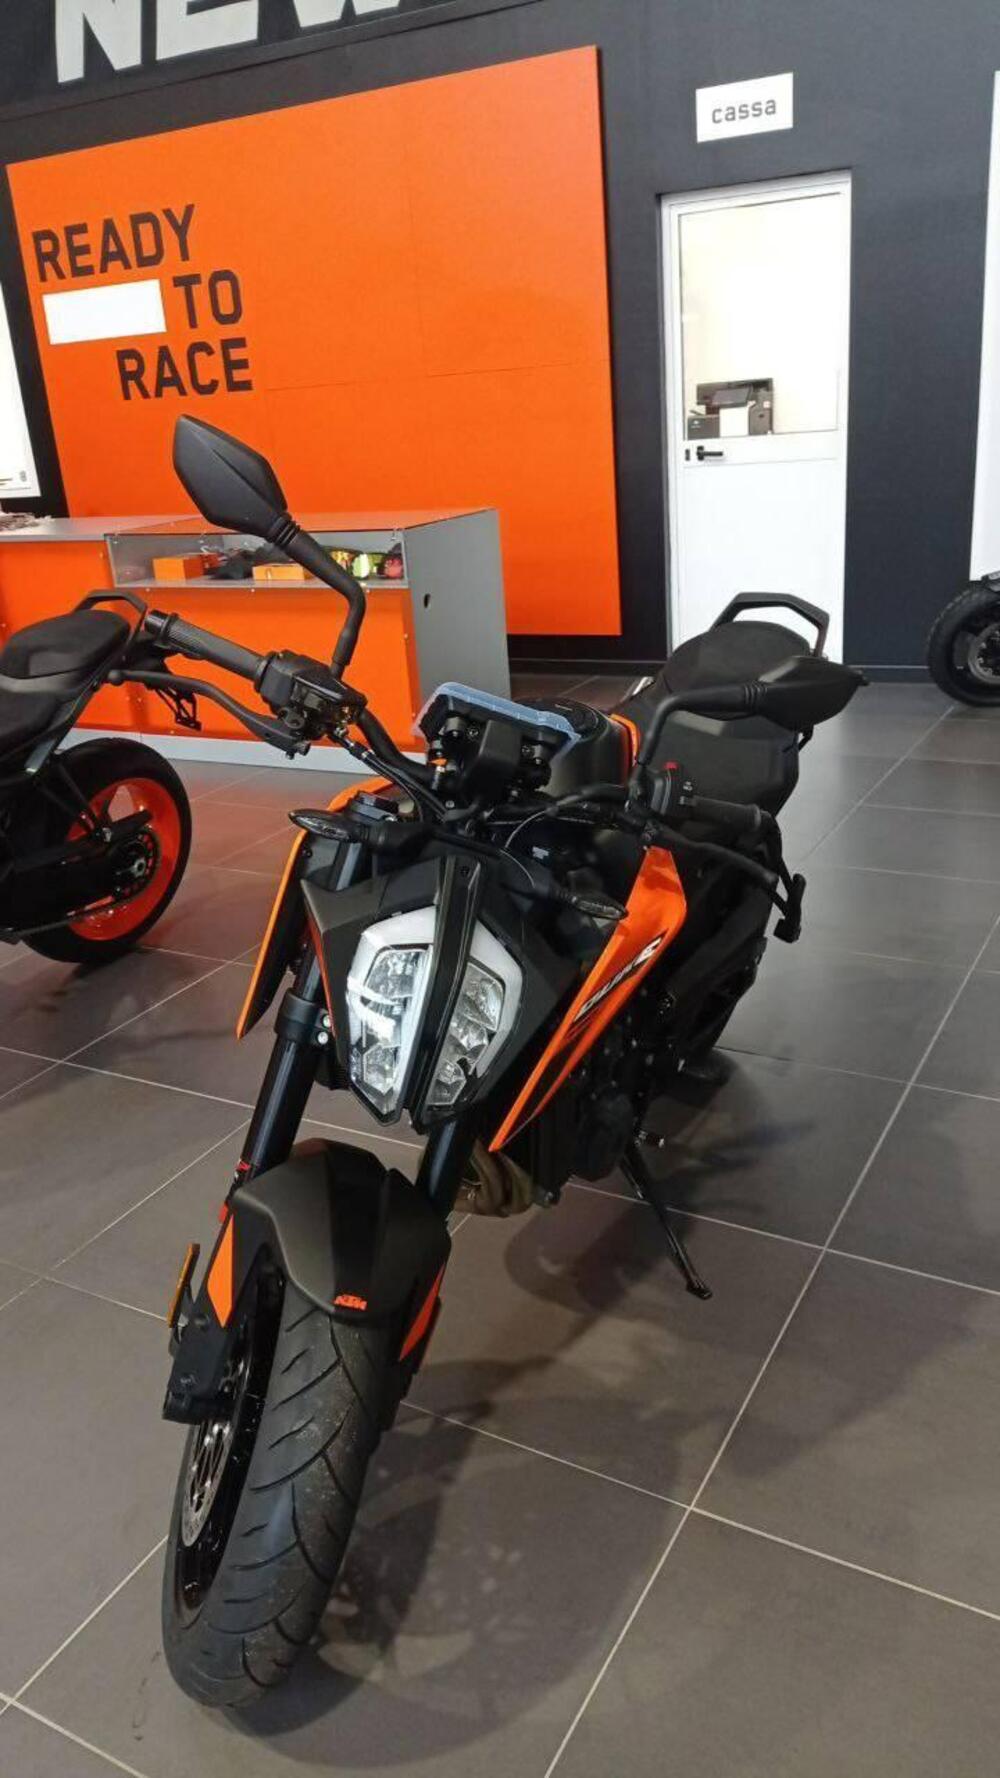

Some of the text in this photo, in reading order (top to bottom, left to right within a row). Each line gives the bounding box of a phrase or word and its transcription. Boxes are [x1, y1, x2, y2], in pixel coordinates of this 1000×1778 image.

[711, 98, 777, 125] cassa
[32, 203, 195, 282] READY
[172, 269, 243, 329] TO
[116, 337, 253, 400] RACE
